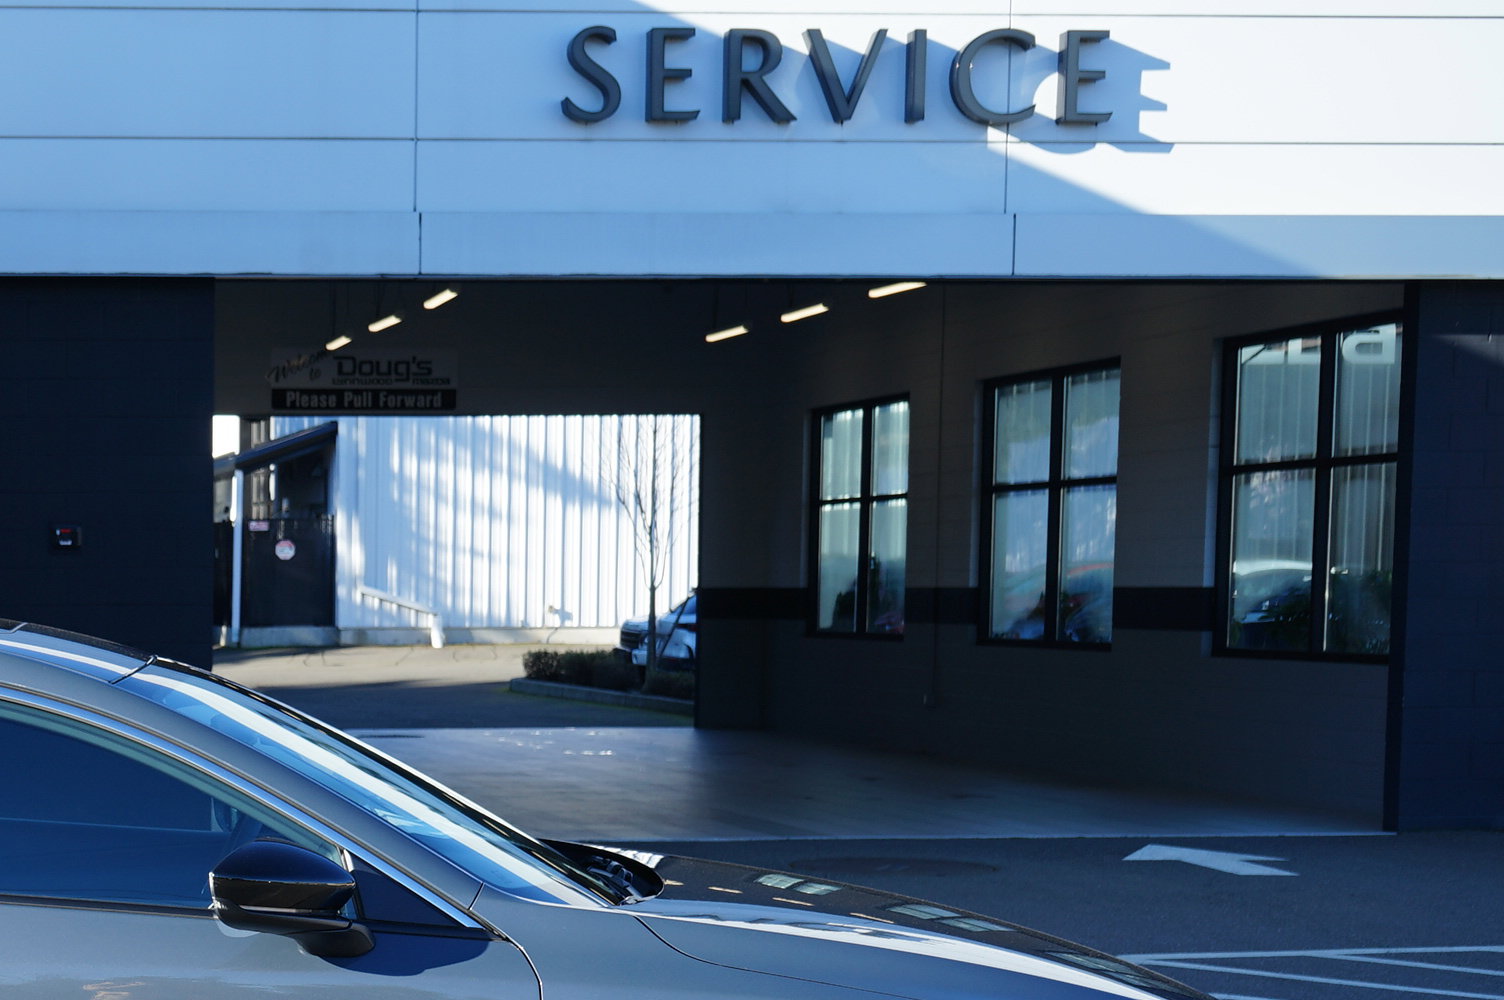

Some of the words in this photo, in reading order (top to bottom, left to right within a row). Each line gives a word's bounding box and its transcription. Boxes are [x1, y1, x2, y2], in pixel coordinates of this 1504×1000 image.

[561, 26, 1113, 126] SERVICE
[266, 349, 330, 382] Welcom
[333, 356, 433, 382] Doug's
[286, 391, 338, 409] Please
[343, 391, 373, 409] Pull
[379, 391, 443, 409] Forward
